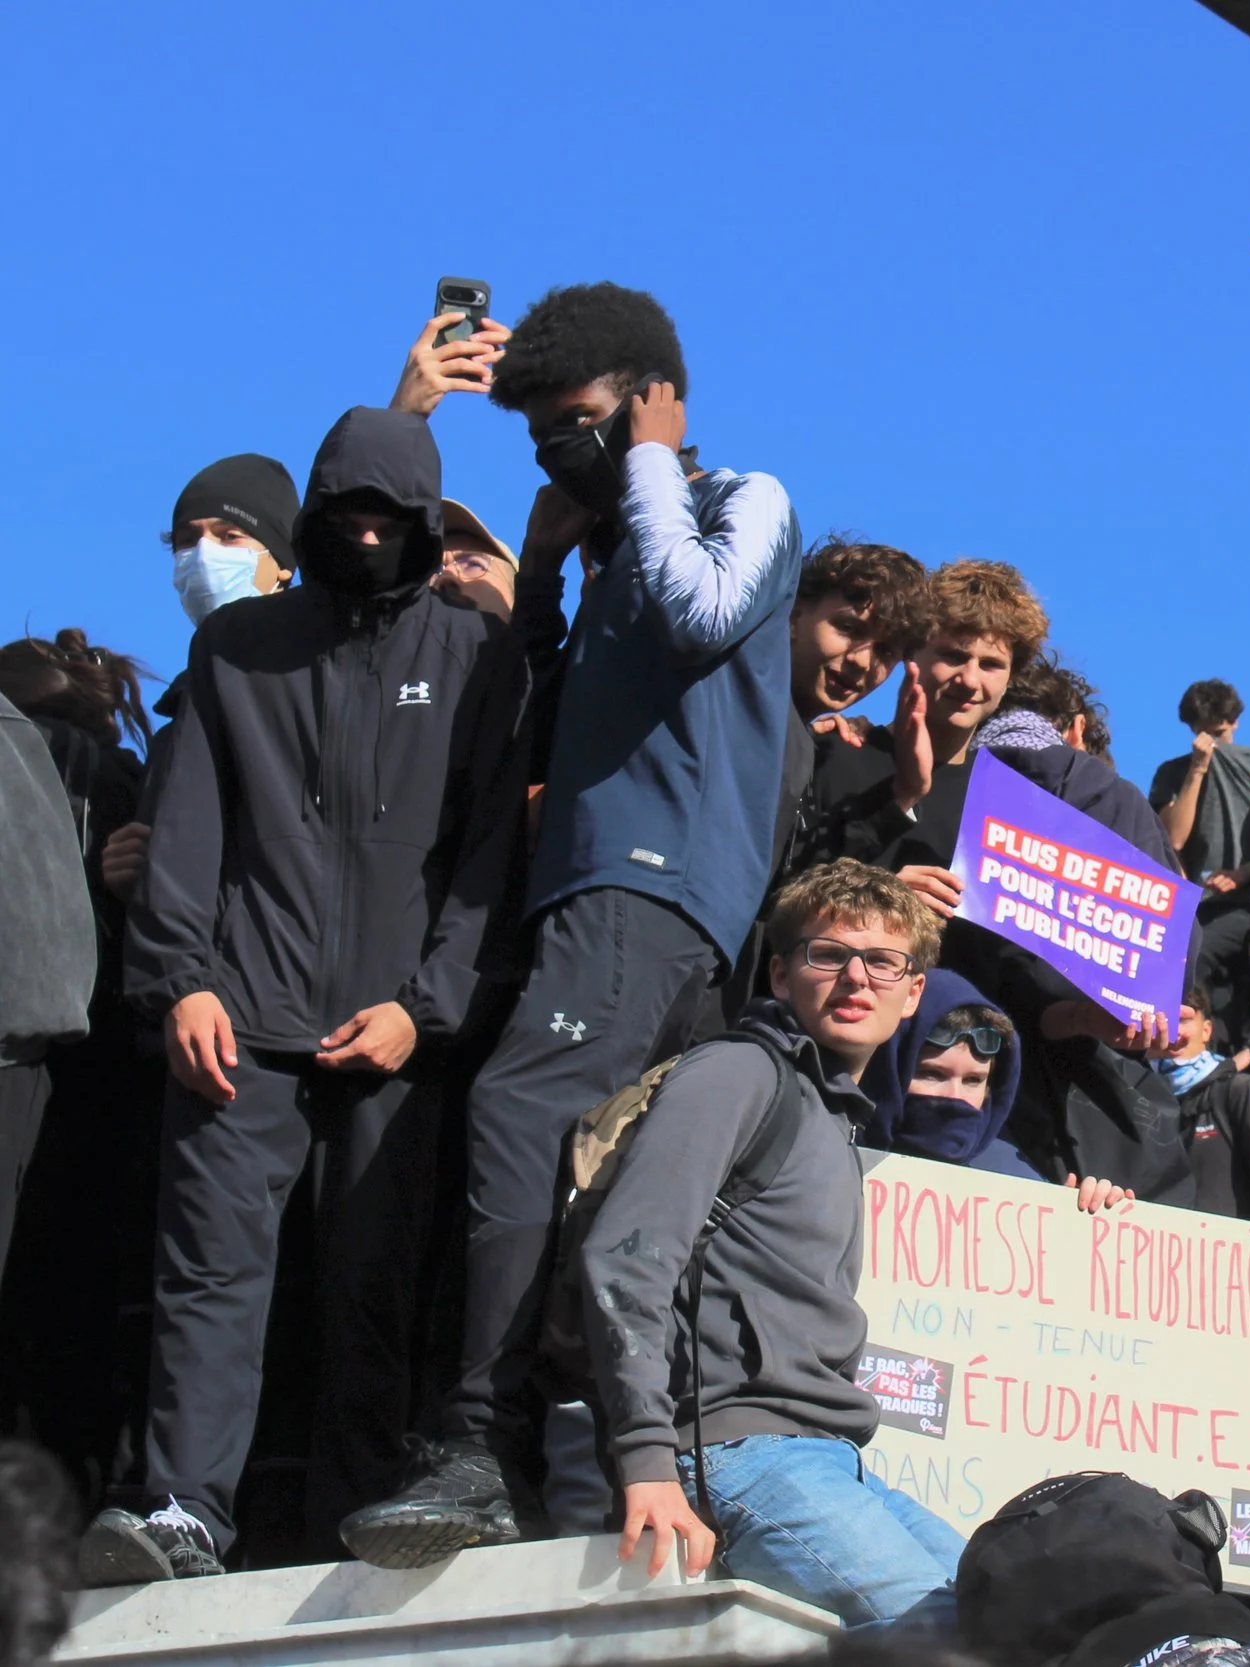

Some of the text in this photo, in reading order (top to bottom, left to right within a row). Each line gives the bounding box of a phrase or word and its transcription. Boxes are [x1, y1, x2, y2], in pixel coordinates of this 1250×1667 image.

[979, 856, 1167, 953] POUR L'ÉCOLE
[986, 822, 1172, 913] PLUS DE FRIC
[993, 895, 1126, 975] PUBLIQUE
[866, 1178, 1055, 1305] PROMESSE
[892, 1298, 974, 1336] NON
[1034, 1321, 1155, 1366] TENUE
[878, 1374, 937, 1401] PAS LES
[868, 1447, 984, 1517] DANS
